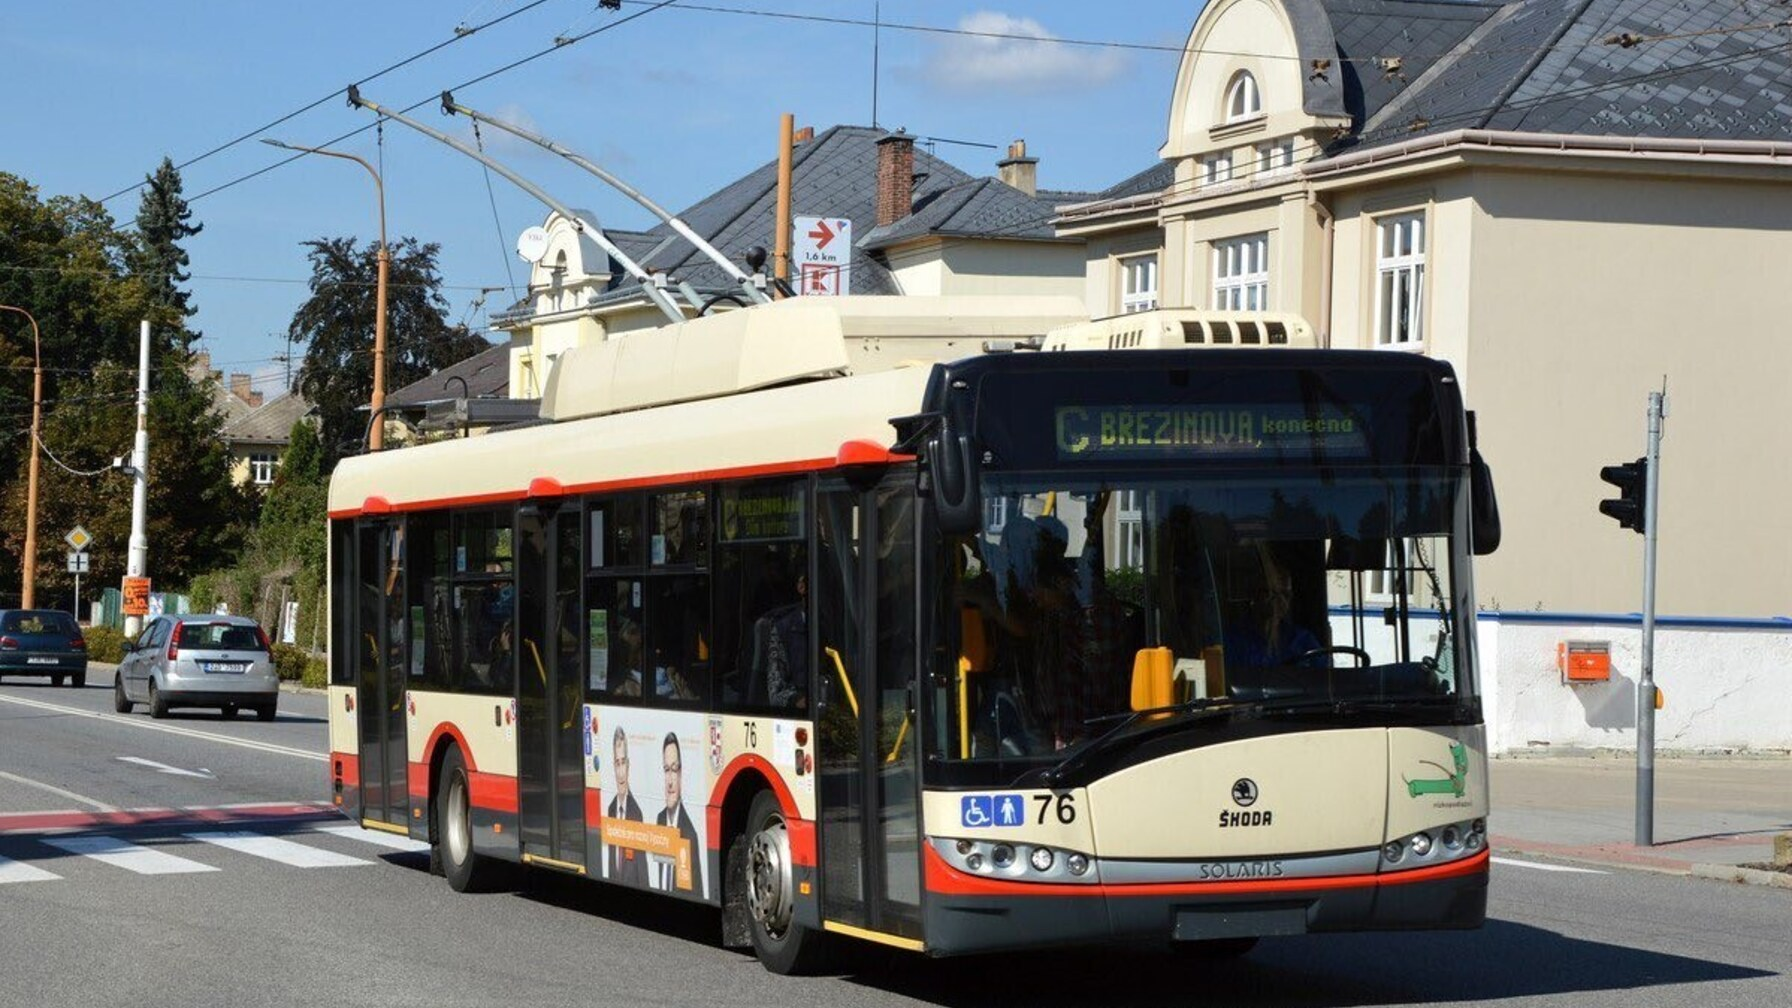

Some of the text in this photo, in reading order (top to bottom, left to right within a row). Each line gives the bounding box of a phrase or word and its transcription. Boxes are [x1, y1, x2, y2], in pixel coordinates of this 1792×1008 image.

[805, 252, 837, 262] 1,6 km
[1056, 406, 1089, 453] C
[743, 721, 757, 748] 76
[1033, 793, 1076, 825] 76
[1219, 809, 1273, 828] ŠKODA
[1200, 861, 1284, 879] SOLARIS
